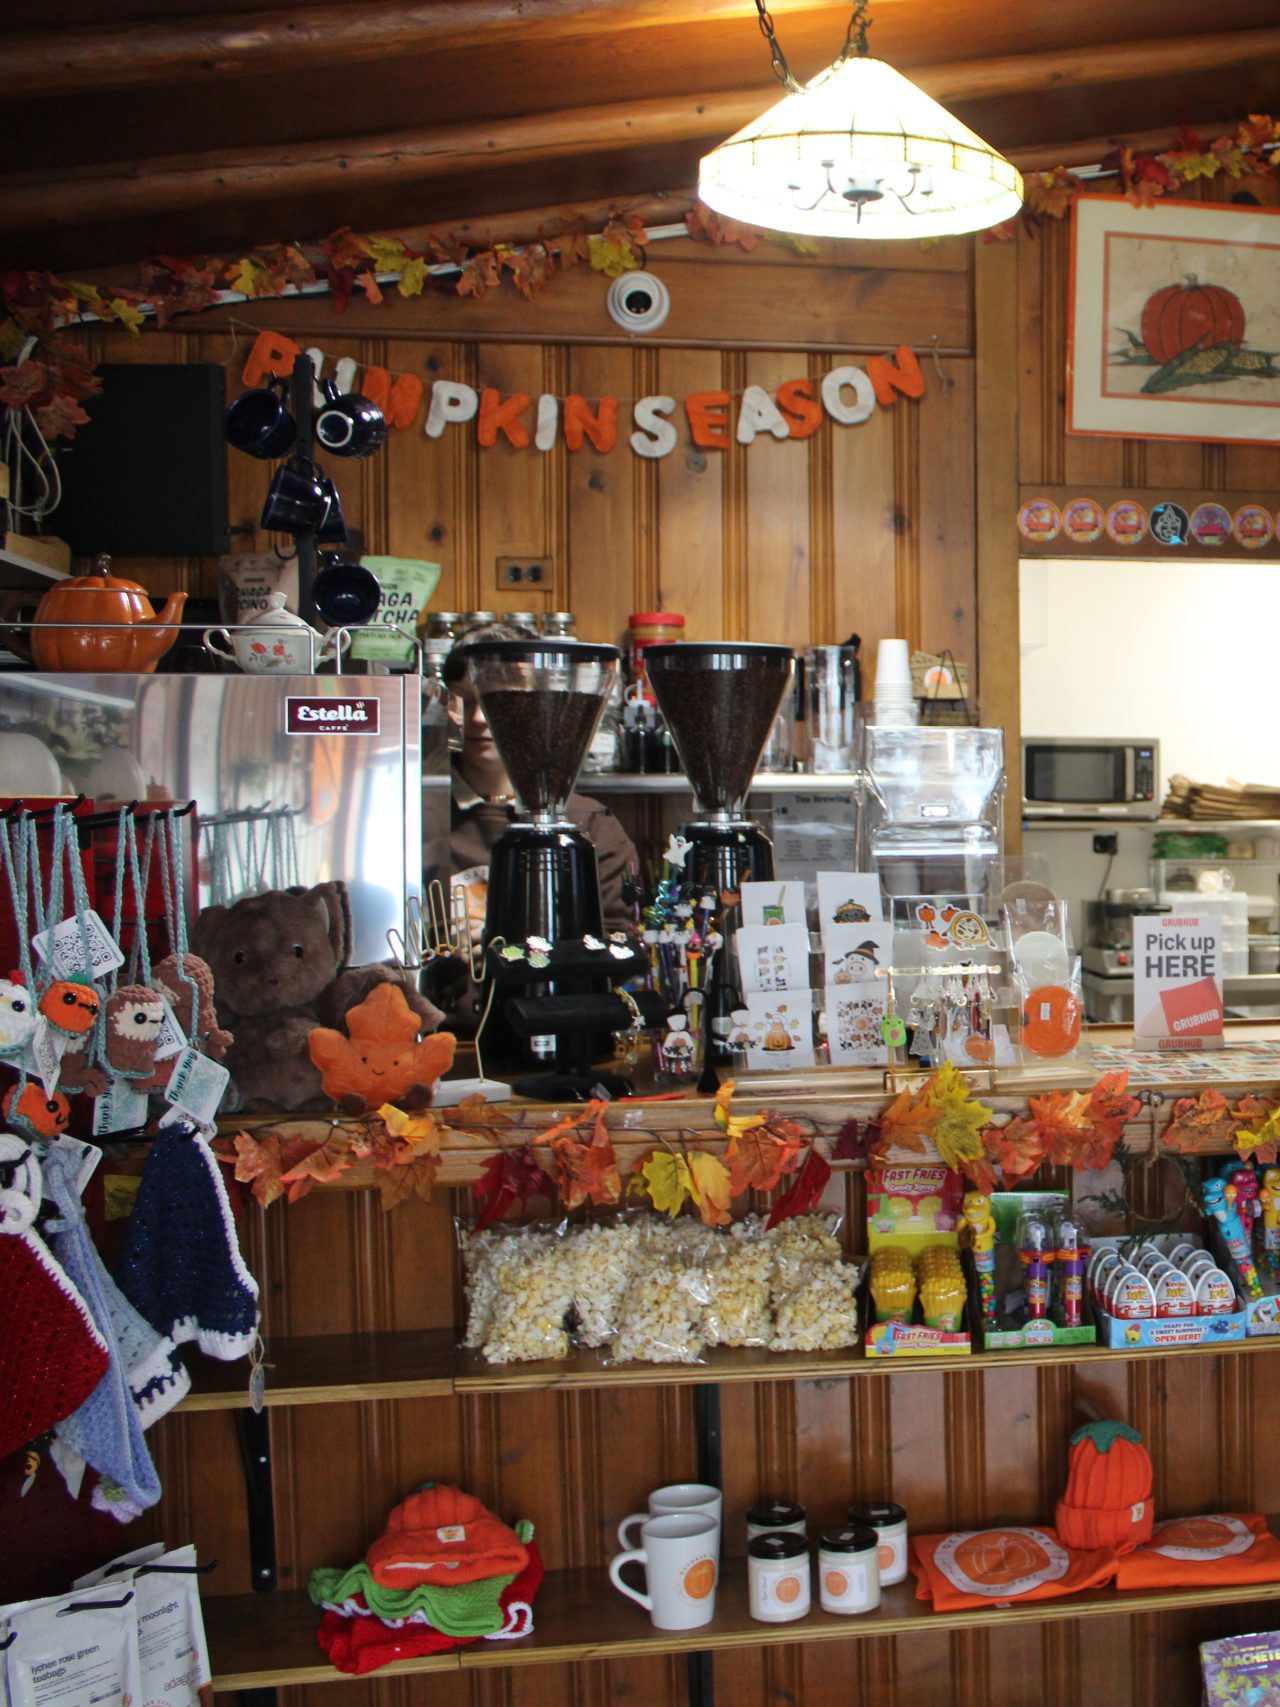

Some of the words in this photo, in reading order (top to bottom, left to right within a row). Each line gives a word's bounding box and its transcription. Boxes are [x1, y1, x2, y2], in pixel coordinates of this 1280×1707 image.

[629, 345, 925, 457] SEASON
[379, 592, 412, 607] AGA
[373, 610, 419, 624] TCHA
[298, 705, 368, 721] Estella
[1162, 918, 1199, 926] GRUBHUB
[1146, 934, 1186, 950] Pick
[1191, 936, 1216, 953] up
[1145, 955, 1216, 978] HERE
[1173, 1009, 1220, 1031] GRUBHUB
[1159, 1038, 1203, 1049] GRUBHUB
[168, 1072, 186, 1101] Thank
[183, 1052, 198, 1072] You
[884, 1170, 912, 1181] FAST
[913, 1169, 946, 1180] FRIES
[896, 1331, 917, 1341] FAST
[918, 1332, 941, 1341] FRIES
[1155, 1334, 1177, 1342] OPEN
[1178, 1334, 1201, 1342] HERE!
[142, 1601, 180, 1623] moonlight
[31, 1660, 57, 1674] lychee
[59, 1655, 76, 1664] rose
[77, 1645, 100, 1660] green
[32, 1667, 67, 1684] teabags
